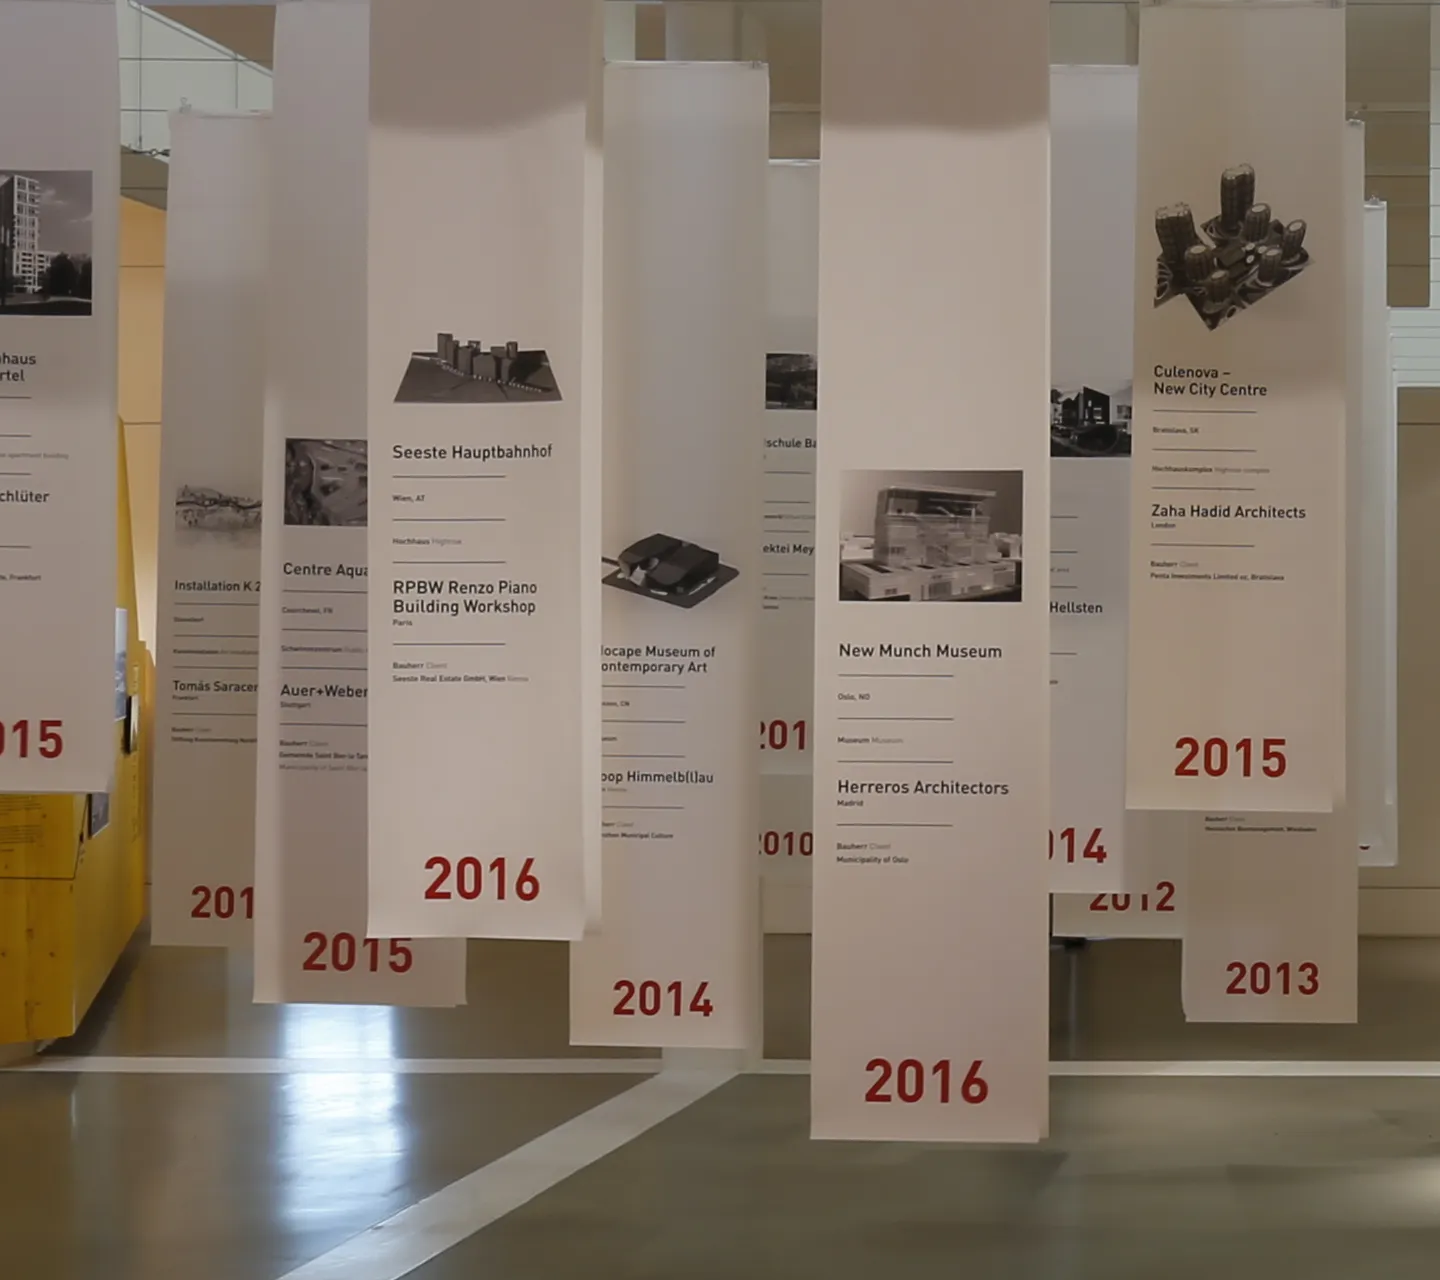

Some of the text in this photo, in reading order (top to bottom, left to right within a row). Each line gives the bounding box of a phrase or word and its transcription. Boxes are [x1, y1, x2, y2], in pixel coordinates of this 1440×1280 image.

[1154, 365, 1218, 378] Culenova
[1155, 382, 1267, 398] New City Centre
[393, 444, 552, 462] Seeste Hauptbahnhof
[391, 494, 426, 503] Wien, AT
[1152, 504, 1305, 518] Zaha Hadid Architects
[284, 563, 332, 575] Centre
[175, 580, 240, 591] Installation
[244, 581, 252, 591] K
[394, 580, 537, 594] RPBW Renzo Piano
[394, 600, 535, 616] Building Workshop
[1050, 602, 1102, 613] Hellsten
[392, 618, 413, 627] Paris
[646, 646, 700, 657] Museum
[704, 647, 715, 657] of
[840, 644, 1001, 658] New Munch Museum
[392, 661, 425, 670] Bauherr
[602, 661, 707, 675] ontemporary Art
[392, 674, 419, 683] Seeste
[419, 674, 438, 683] Real
[438, 674, 462, 683] Estate
[488, 675, 506, 683] Wien
[173, 680, 210, 691] Tomás
[281, 684, 367, 697] Auer+Weber
[837, 692, 871, 701] Oslo, NO
[837, 736, 871, 744] Museum
[1175, 737, 1286, 777] 2015
[839, 780, 1009, 795] Herreros Architectors
[836, 799, 864, 807] Madrid
[836, 855, 910, 865] Municipality of Oslo
[425, 857, 539, 901] 2016
[303, 932, 412, 973] 2015
[1226, 962, 1318, 995] 2013
[613, 980, 713, 1016] 2014
[865, 1059, 988, 1104] 2016
